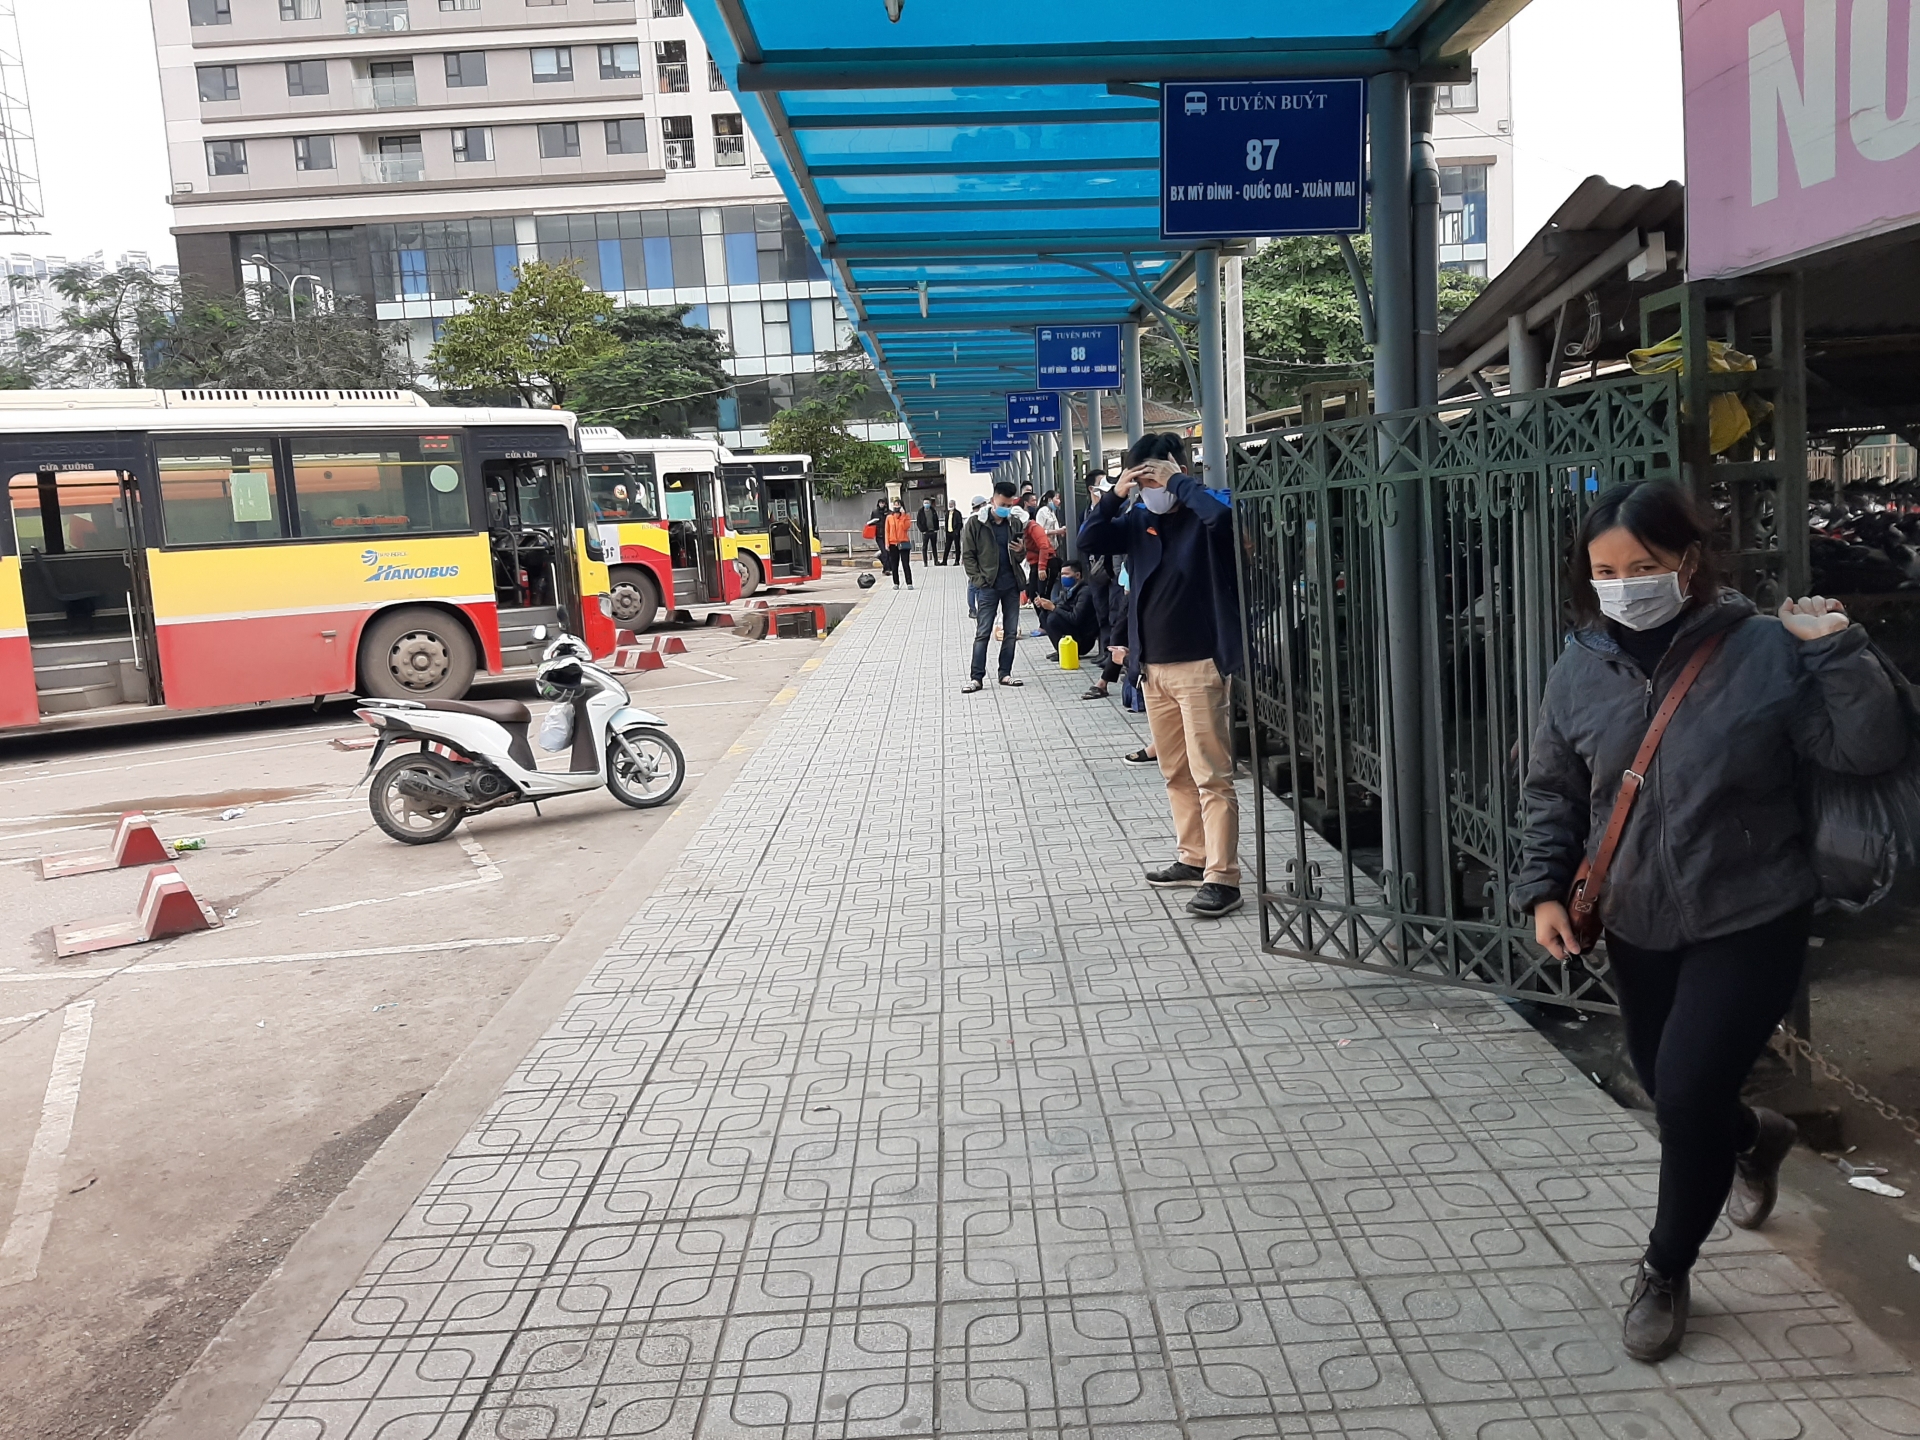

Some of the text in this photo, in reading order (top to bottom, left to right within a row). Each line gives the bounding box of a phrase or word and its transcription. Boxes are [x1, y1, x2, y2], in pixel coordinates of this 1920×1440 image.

[1218, 90, 1328, 111] TUYẾN BUÝT
[1246, 139, 1280, 171] 87
[1170, 185, 1185, 201] BX
[1188, 183, 1204, 200] MỸ
[1207, 181, 1233, 200] ĐÌNH
[1243, 178, 1271, 201] QUỐC
[1274, 183, 1292, 198] OAI
[1302, 179, 1331, 198] XUÂN
[1335, 181, 1356, 197] MAI
[1071, 346, 1086, 361] 88
[1028, 405, 1039, 415] 78
